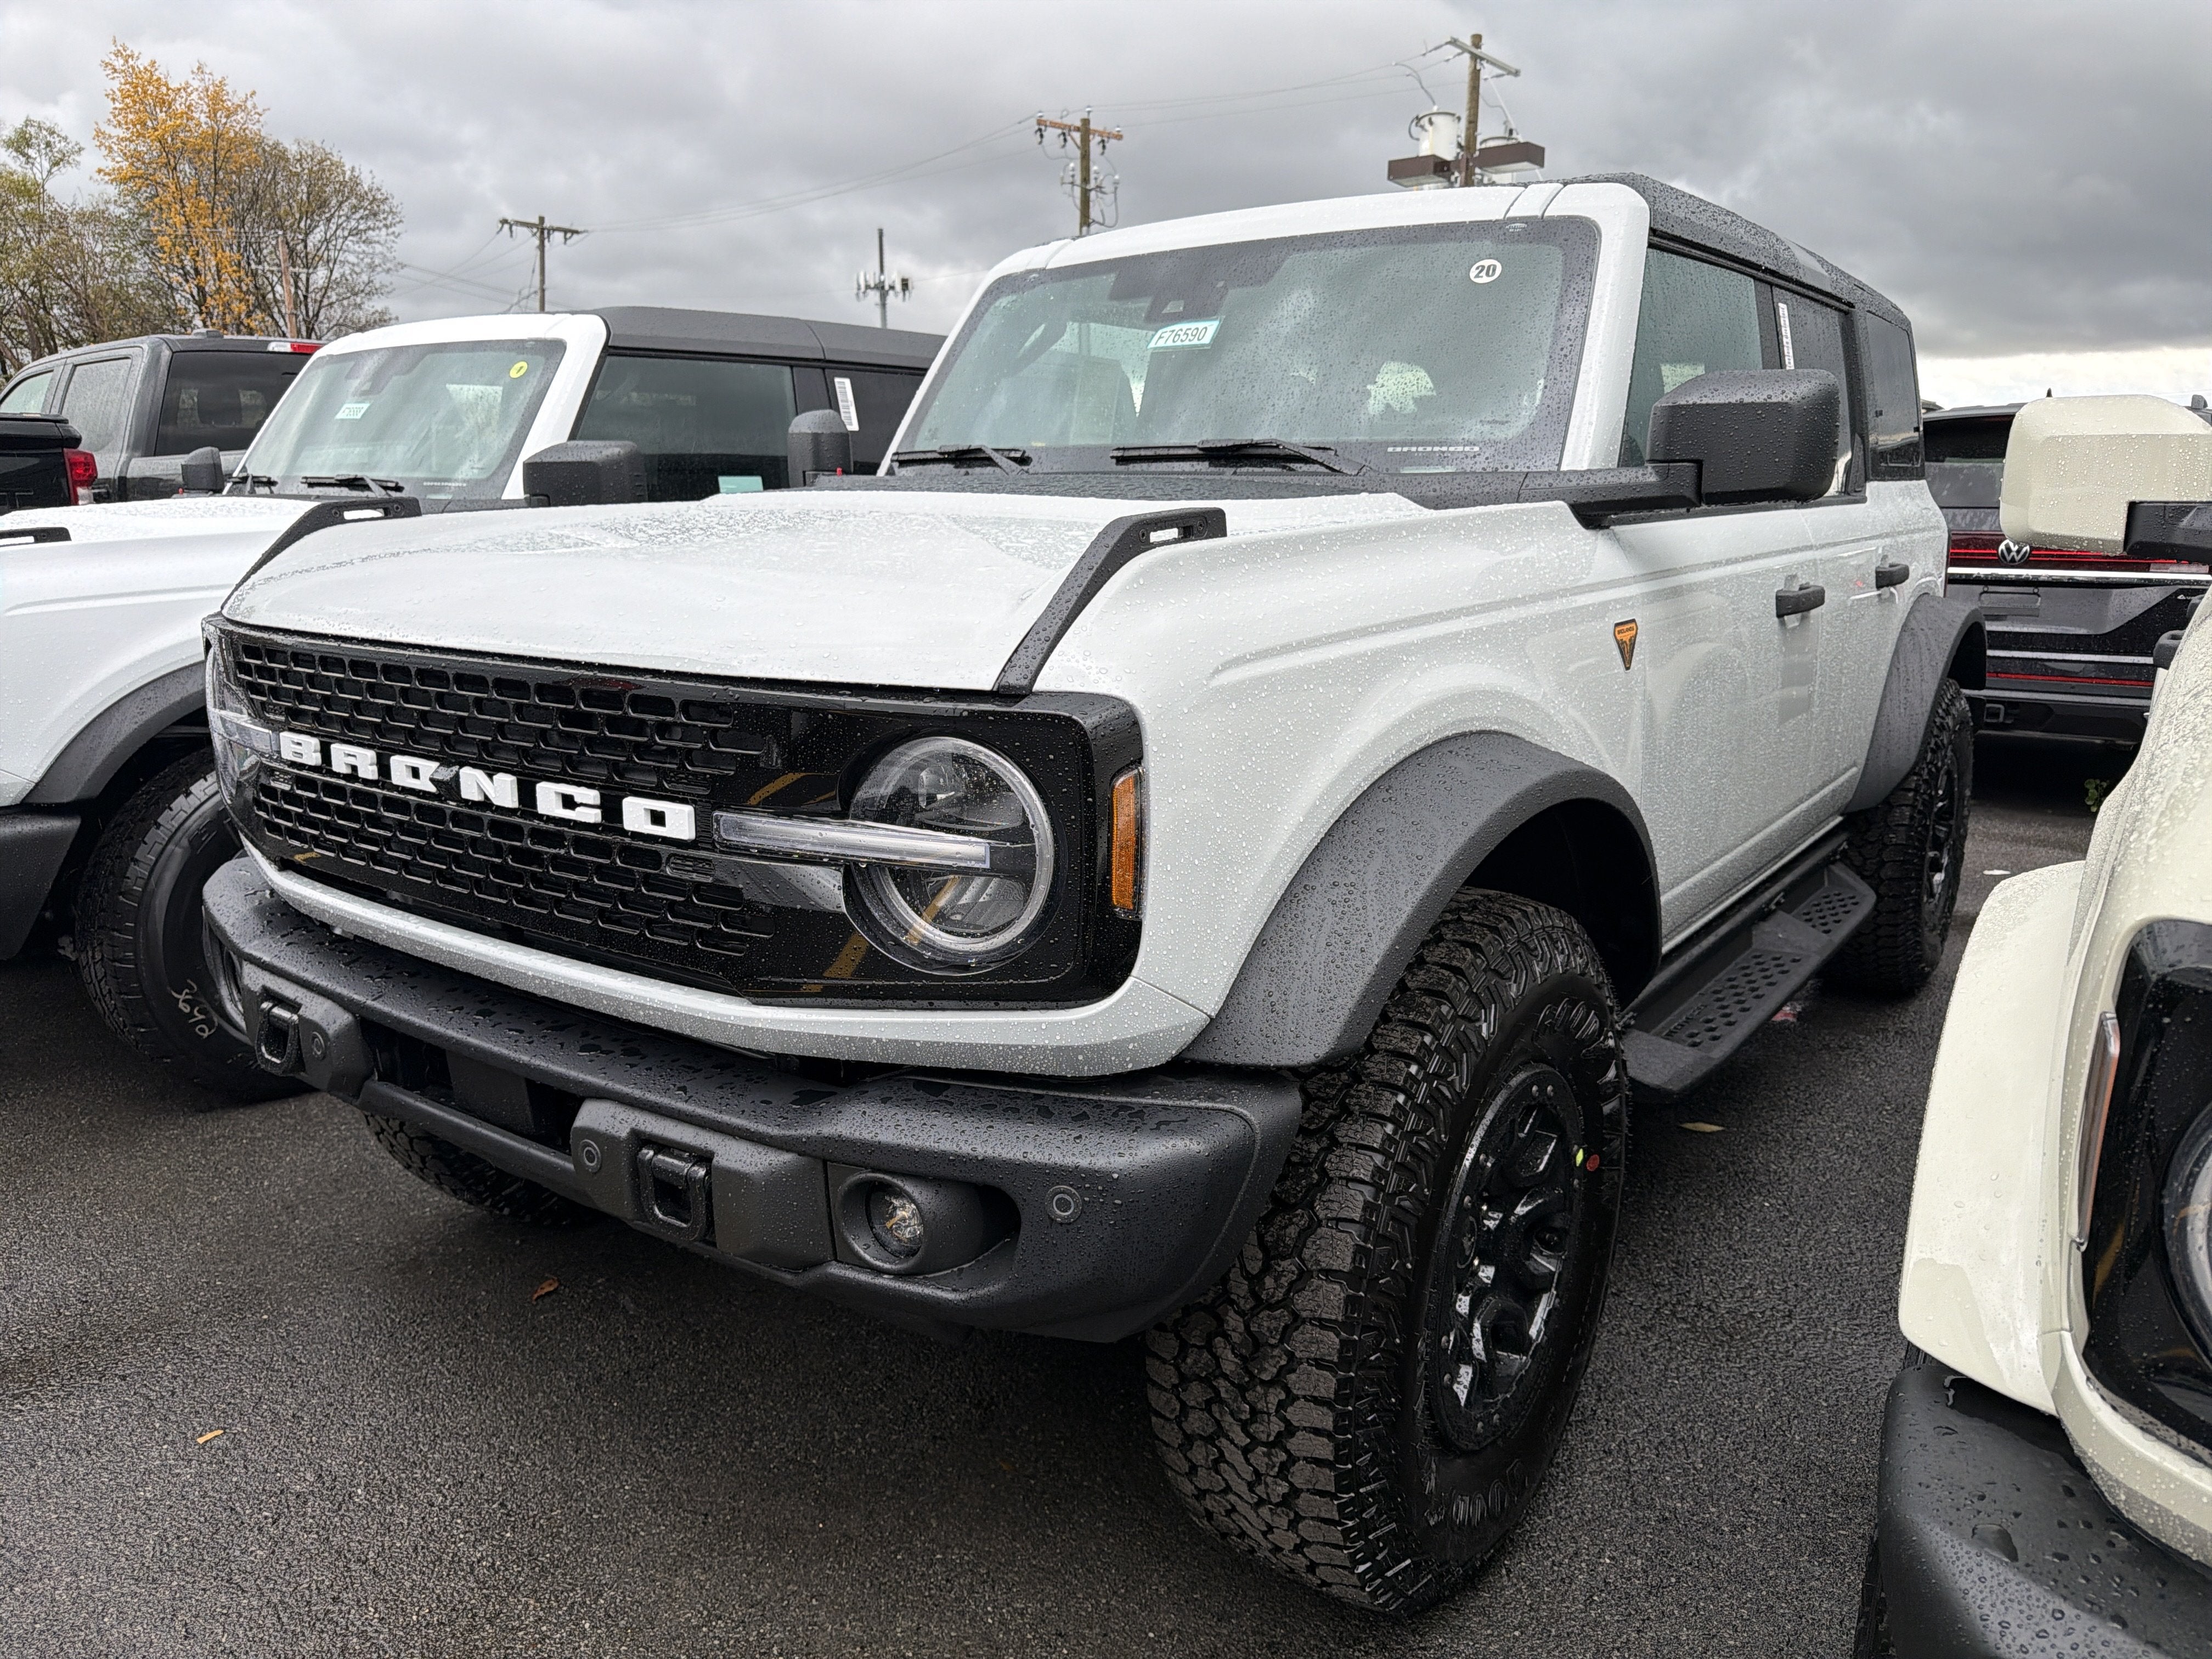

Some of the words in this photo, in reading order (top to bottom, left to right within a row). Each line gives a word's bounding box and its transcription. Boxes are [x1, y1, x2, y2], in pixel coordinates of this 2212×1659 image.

[1474, 264, 1497, 279] 20
[1154, 326, 1208, 346] F76590
[279, 731, 696, 840] BRONCO
